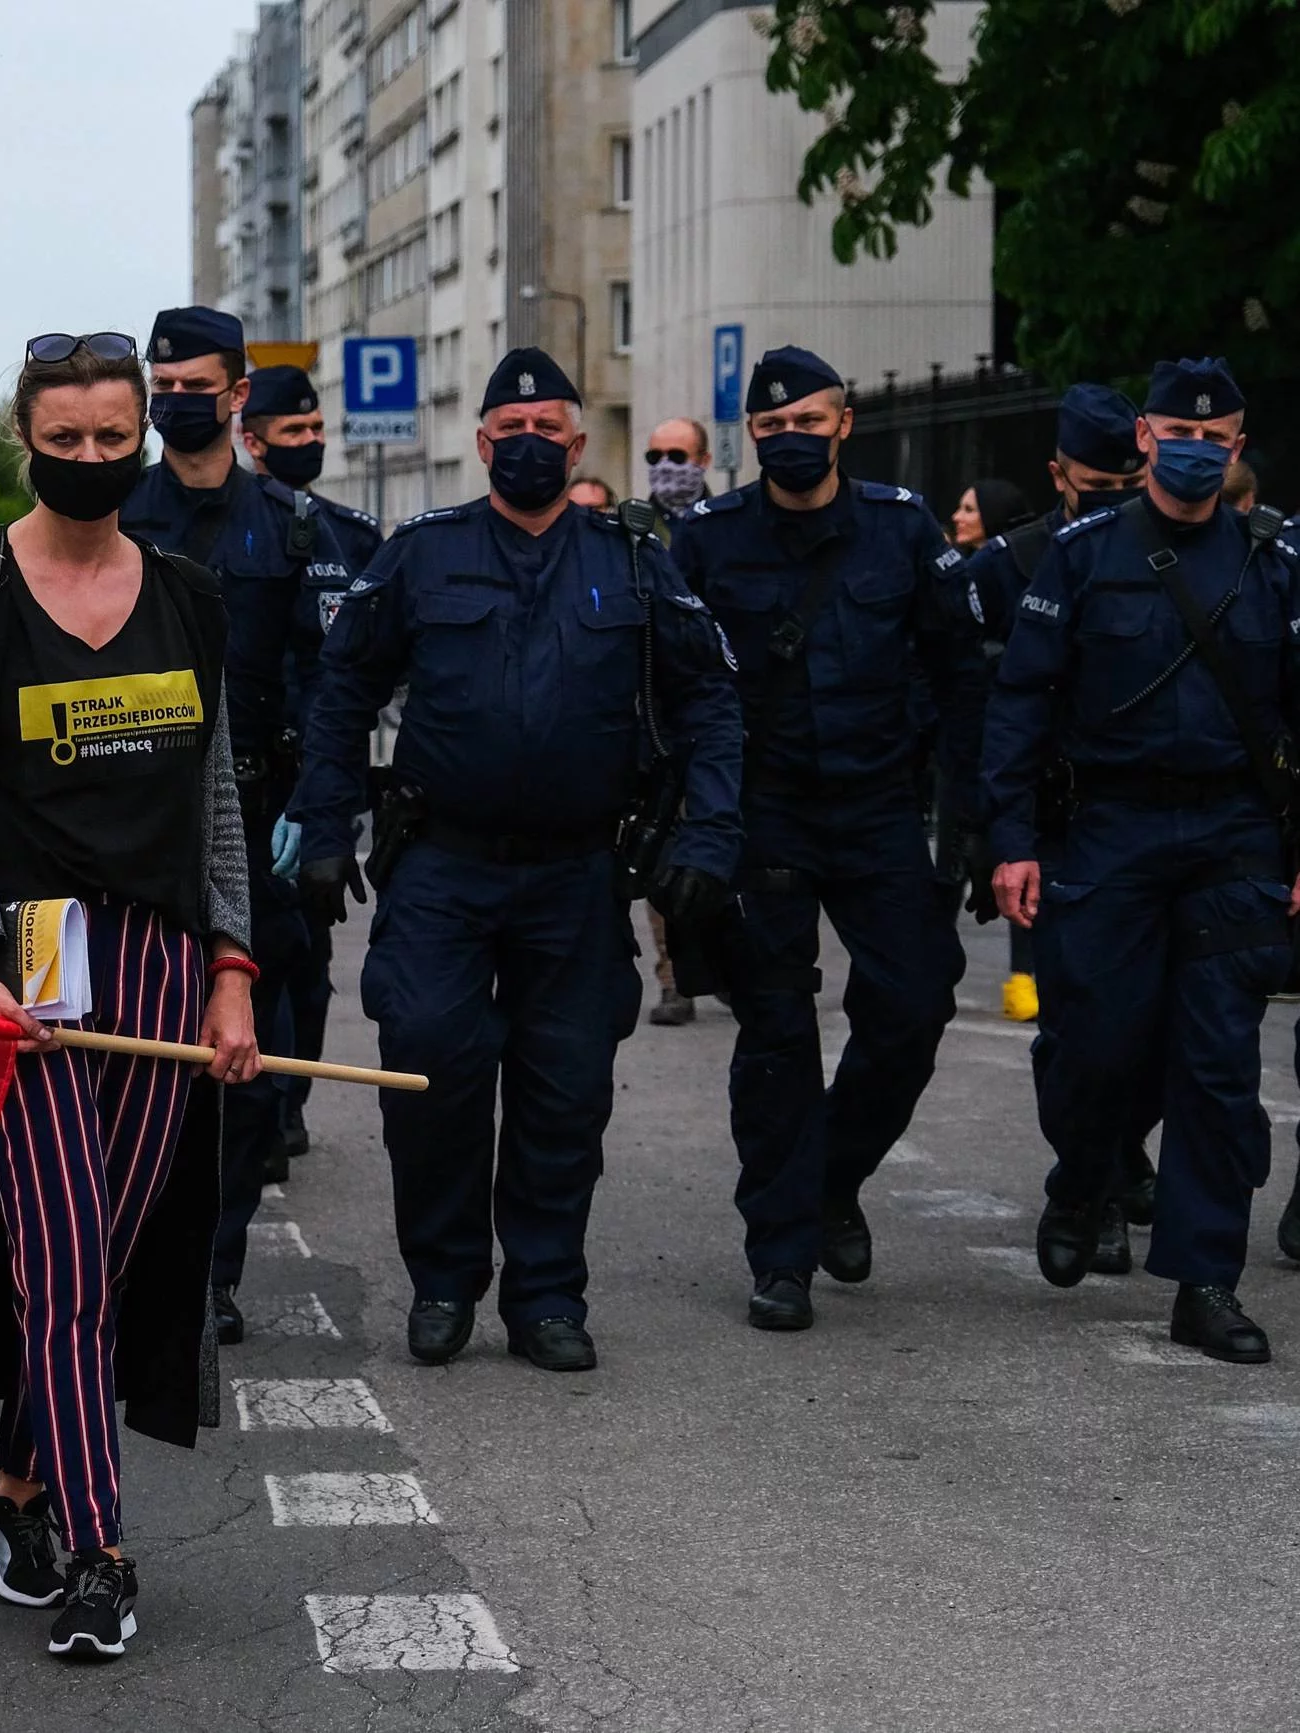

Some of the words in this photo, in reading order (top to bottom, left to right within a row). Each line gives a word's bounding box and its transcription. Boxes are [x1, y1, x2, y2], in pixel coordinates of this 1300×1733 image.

[360, 345, 402, 402] P
[718, 331, 736, 392] P
[71, 696, 124, 714] STRAJK
[73, 704, 196, 731] PRZEDSIĘBIORCÓW
[79, 738, 153, 759] #NiePłacę
